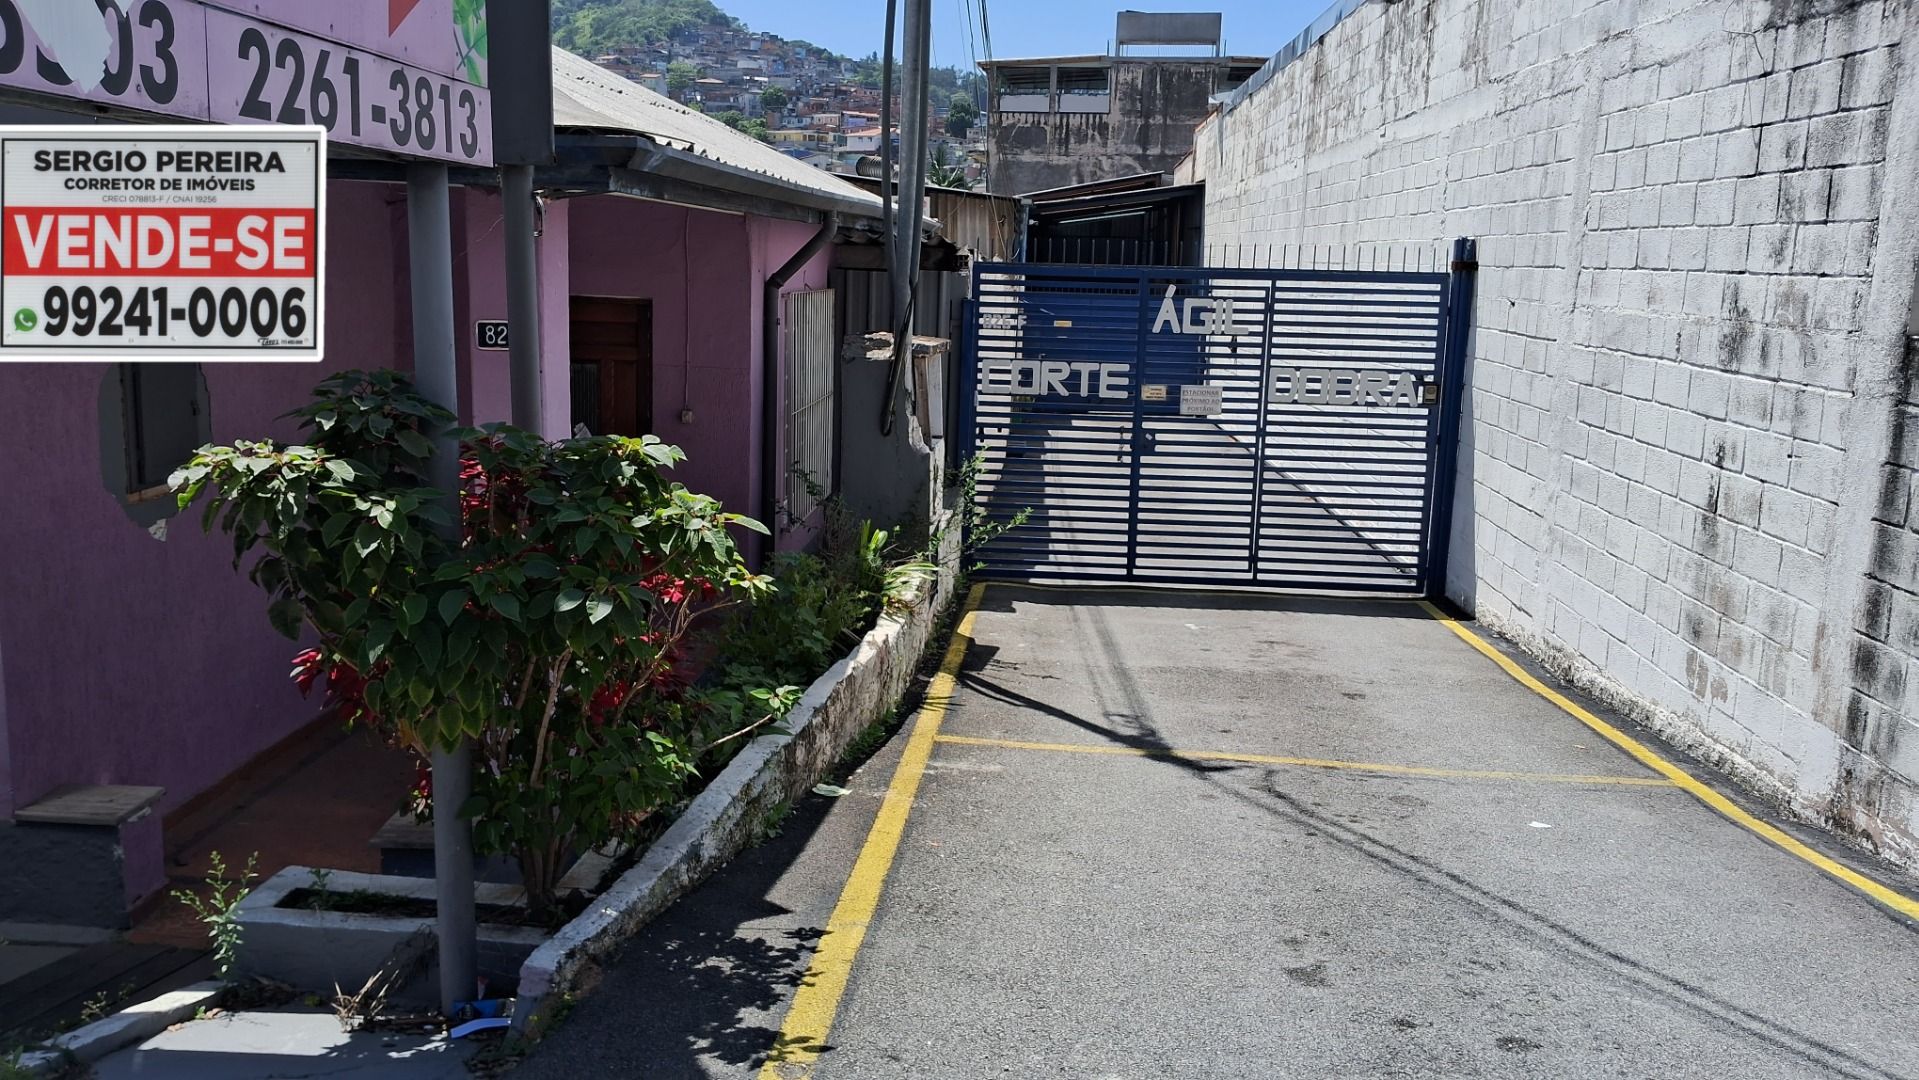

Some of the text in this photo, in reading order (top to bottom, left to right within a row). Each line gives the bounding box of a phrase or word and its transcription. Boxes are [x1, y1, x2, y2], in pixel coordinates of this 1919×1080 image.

[238, 27, 479, 158] 2261-3813
[1152, 284, 1249, 334] ÁGIL
[981, 358, 1418, 407] CORTE DOBRA
